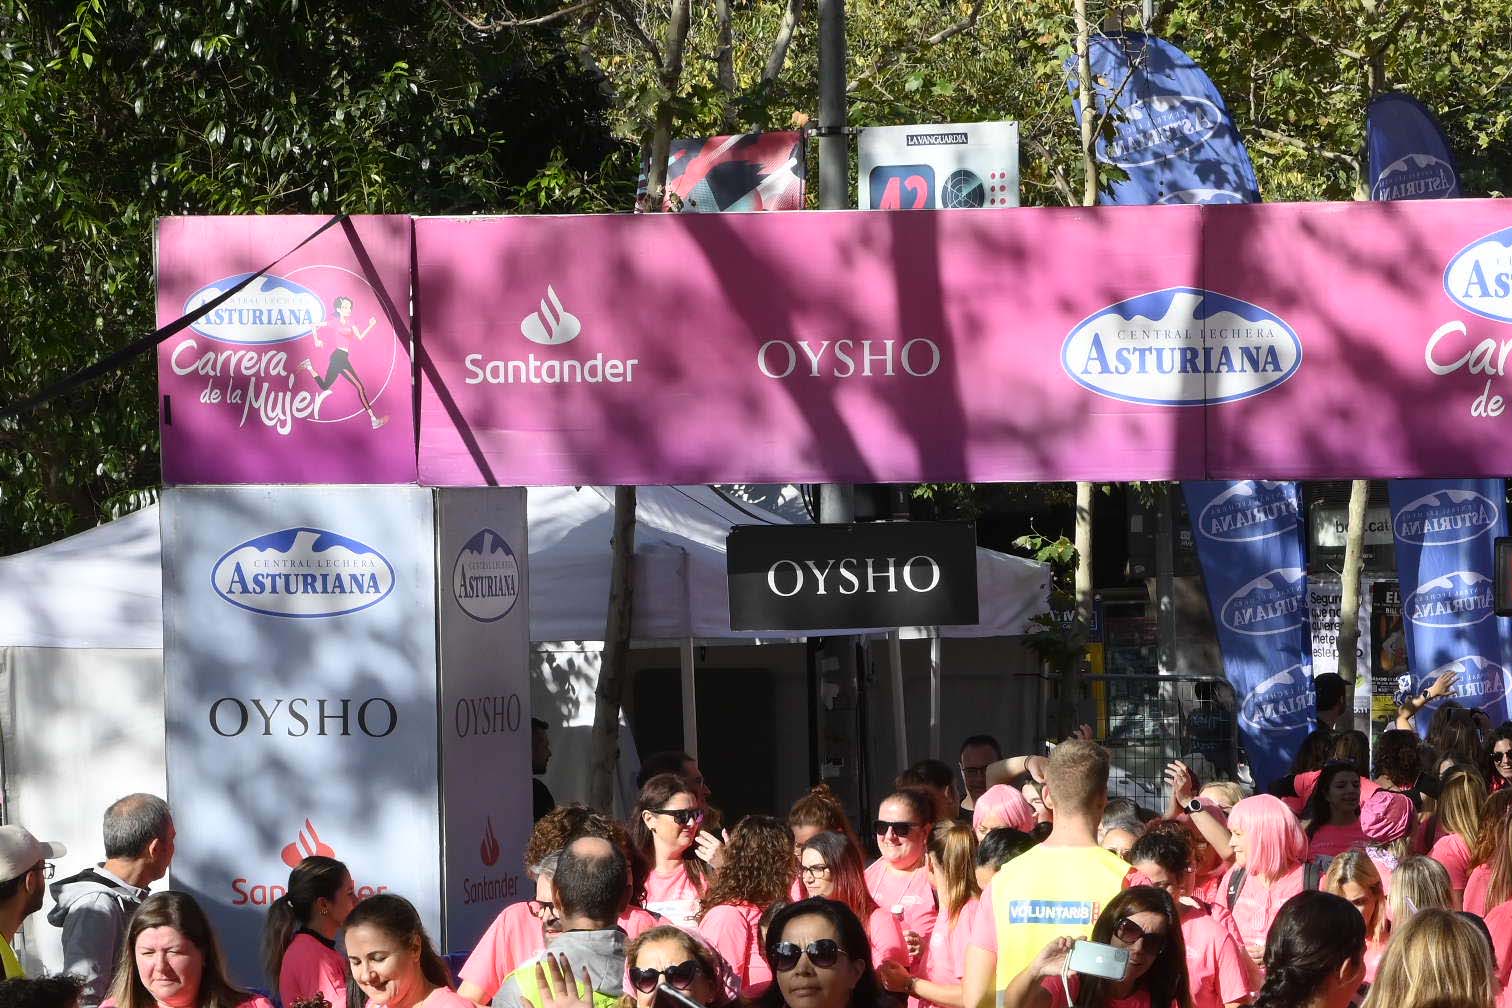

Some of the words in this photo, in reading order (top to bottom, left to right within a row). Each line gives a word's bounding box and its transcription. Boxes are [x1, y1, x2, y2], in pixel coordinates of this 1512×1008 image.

[918, 134, 967, 145] VANGUARDIA
[1117, 328, 1192, 341] CENTRAL
[1200, 327, 1276, 341] LECHERA
[171, 339, 288, 377] Carrera
[464, 352, 639, 385] Santander
[757, 336, 942, 379] OYSHO
[1080, 333, 1283, 376] ASTURIANA
[200, 378, 221, 404] de
[226, 377, 242, 404] la
[239, 374, 333, 436] Mujer
[1469, 380, 1504, 419] de
[226, 561, 382, 596] ASTURIANA
[254, 559, 312, 569] CENTRAL
[317, 559, 376, 569] LECHERA
[458, 563, 516, 599] ASTURIANA
[768, 554, 941, 598] OYSHO
[209, 697, 399, 739] OYSHO
[456, 693, 521, 739] OYSHO
[463, 874, 519, 906] Santander
[1010, 901, 1090, 921] VOLUNTARIS
